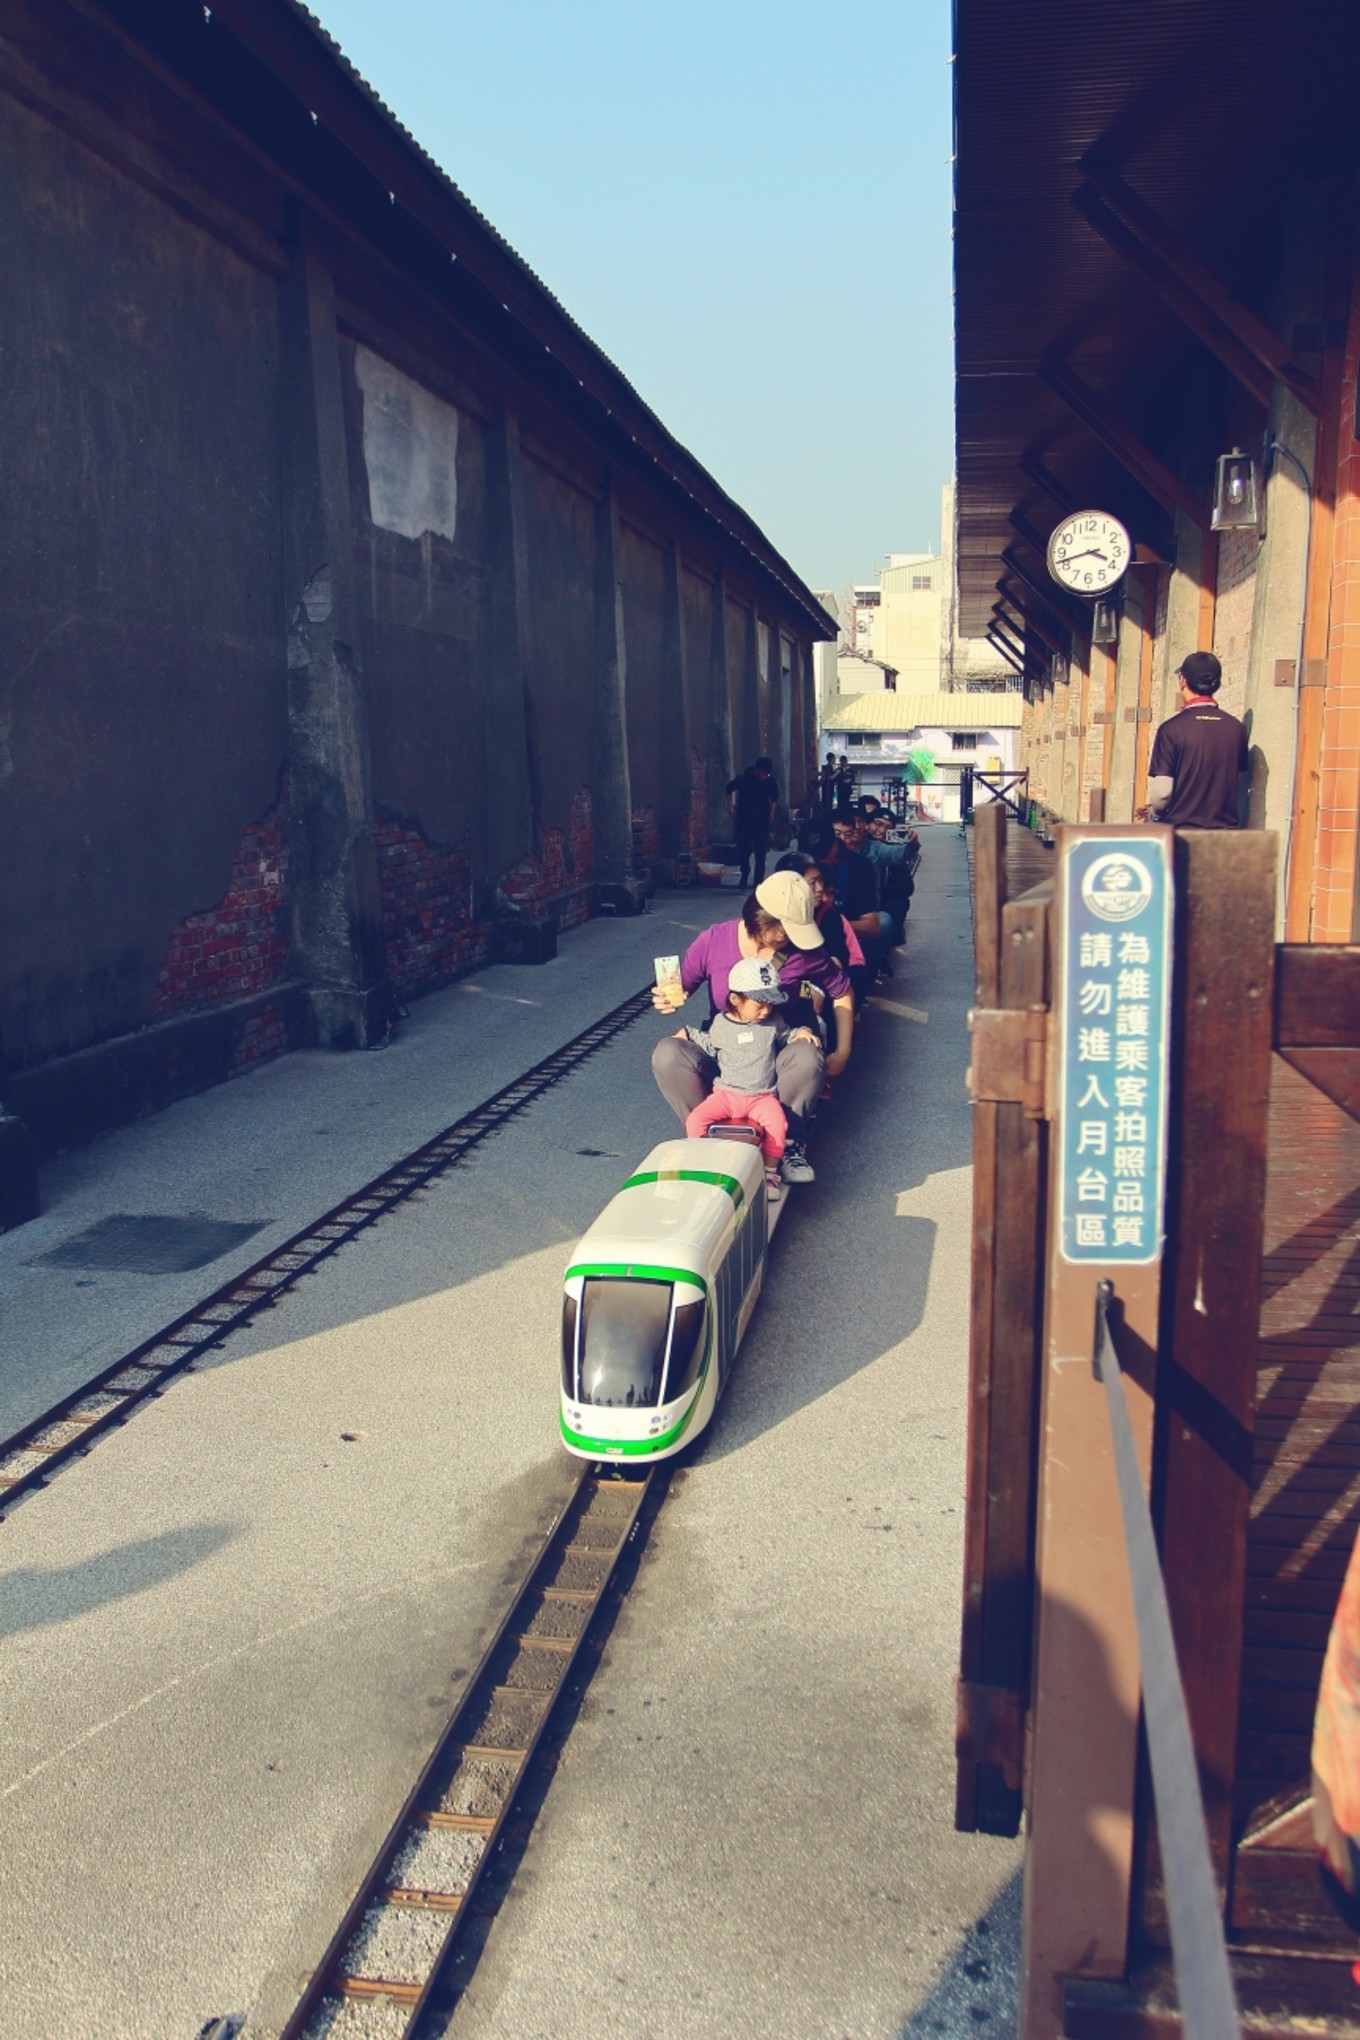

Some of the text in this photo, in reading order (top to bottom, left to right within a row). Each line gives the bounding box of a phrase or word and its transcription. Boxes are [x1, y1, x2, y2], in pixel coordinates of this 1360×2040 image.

[1085, 520, 1097, 532] 12
[1062, 533, 1073, 545] 10
[1109, 532, 1118, 544] 2
[1057, 547, 1067, 559] 9
[1112, 546, 1122, 558] 3
[1062, 560, 1071, 571] 8
[1108, 560, 1116, 570] 4
[1072, 569, 1081, 581] 7
[1084, 573, 1093, 584] 6
[1098, 570, 1107, 581] 5
[1075, 932, 1113, 1248] 請勿進入月台區
[1111, 932, 1150, 1249] 為維護乘客拍照品質
